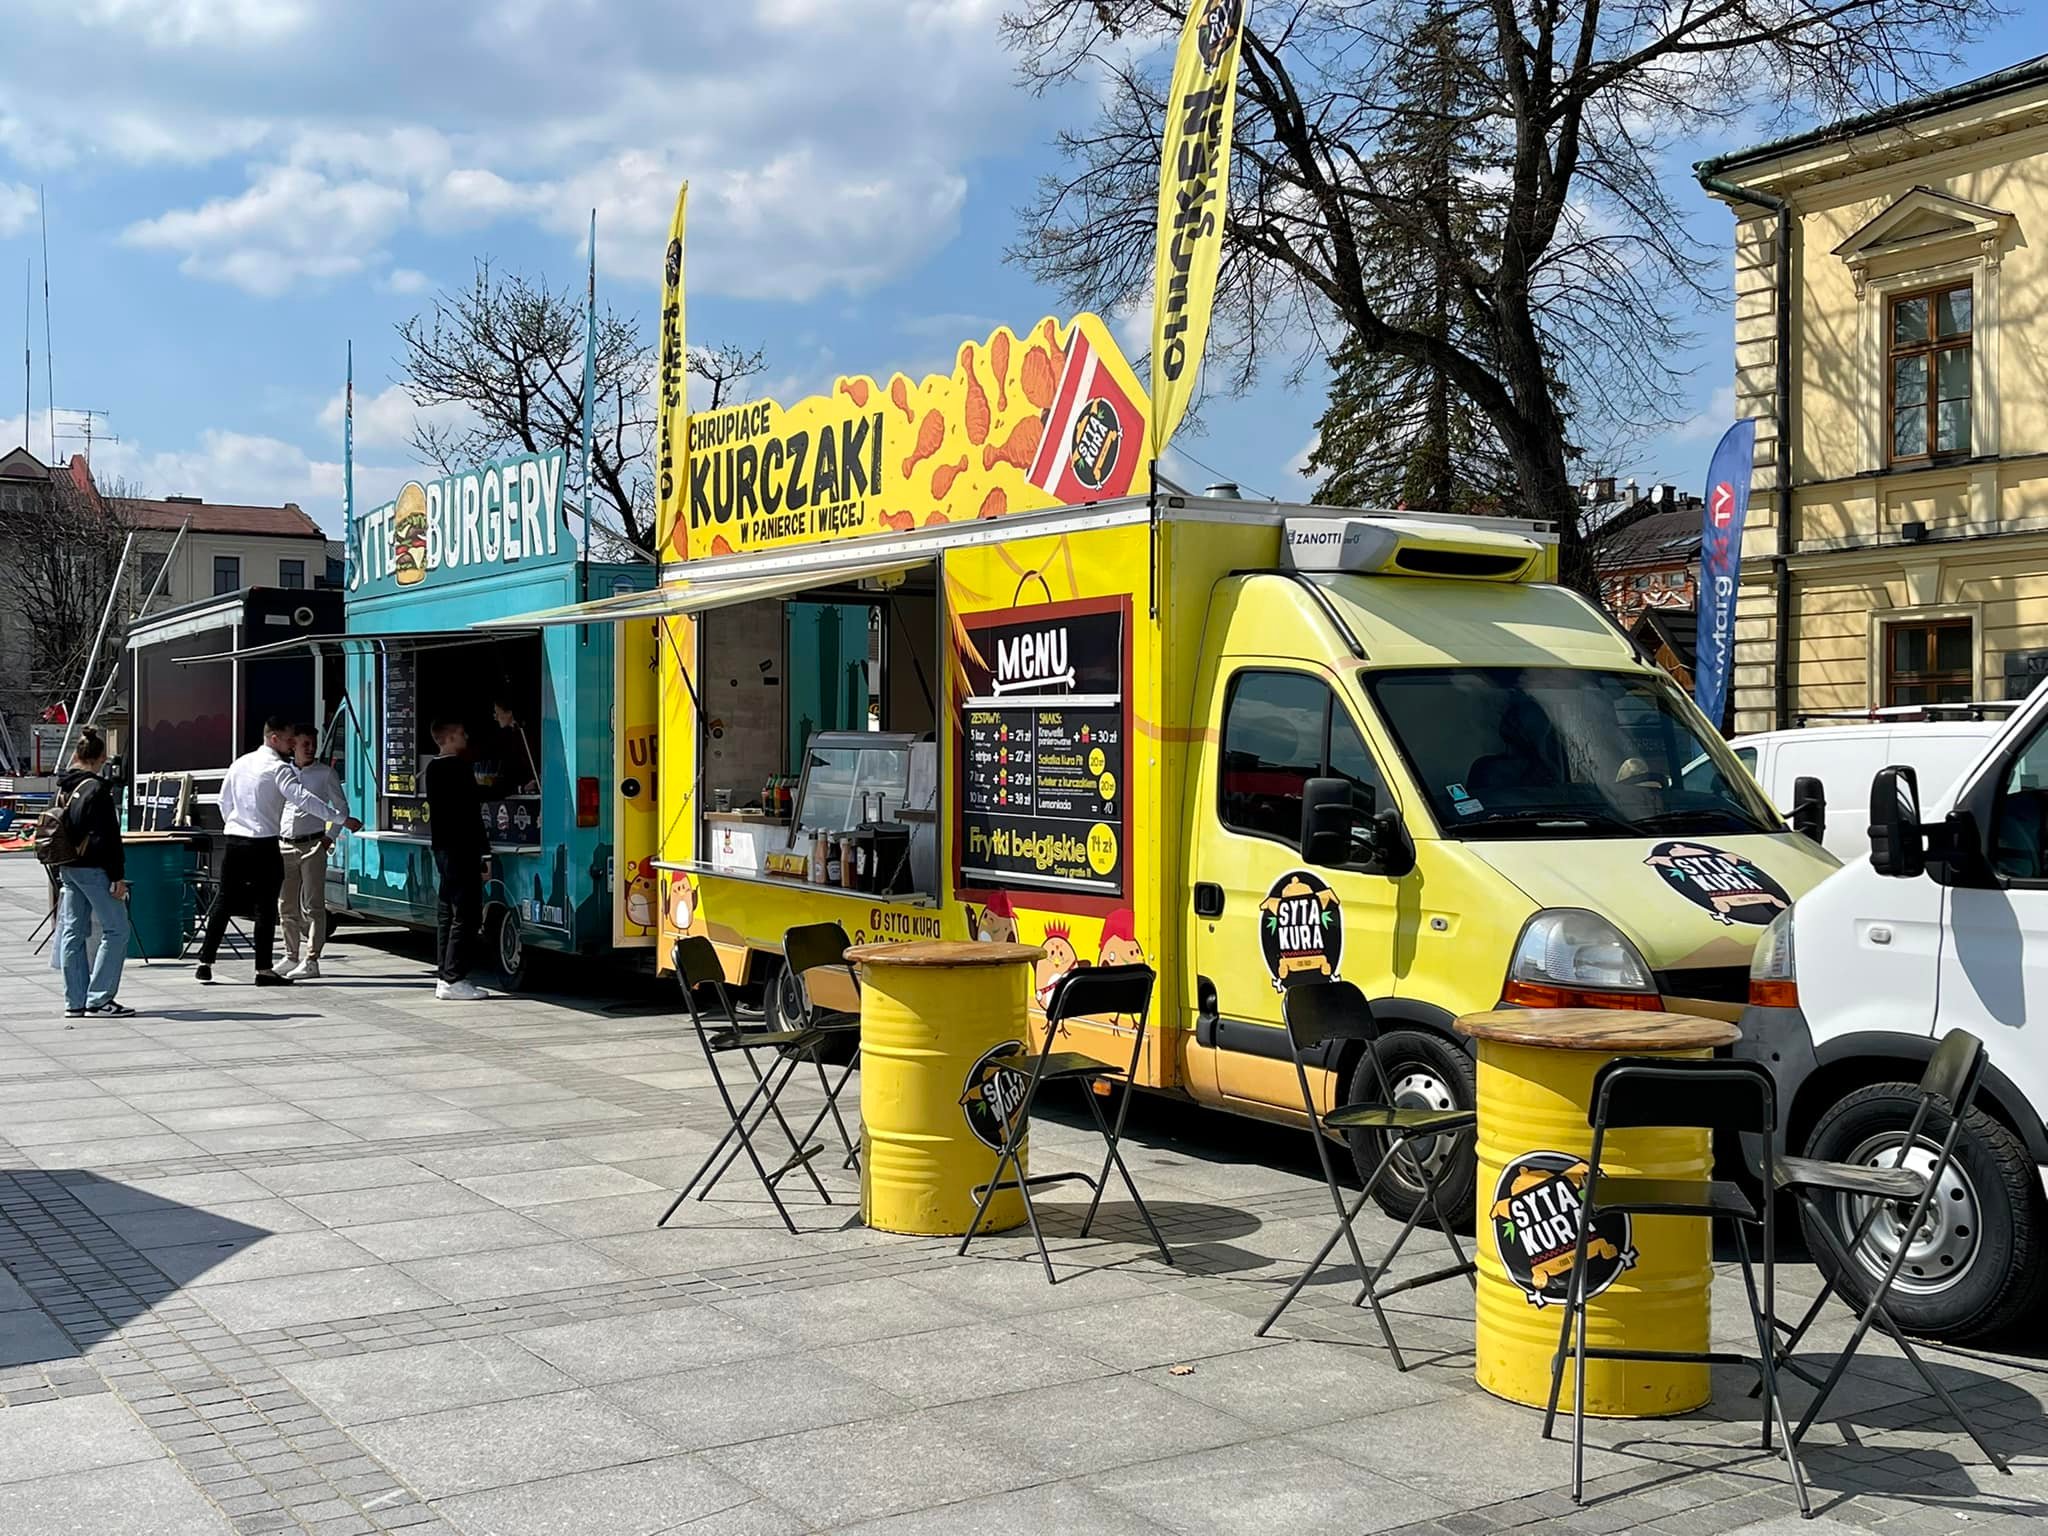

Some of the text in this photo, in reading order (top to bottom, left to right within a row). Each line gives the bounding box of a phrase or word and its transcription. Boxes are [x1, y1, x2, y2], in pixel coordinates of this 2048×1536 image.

[689, 402, 770, 452] CHRUPIĄCE
[1079, 416, 1100, 457] SYTA
[1084, 424, 1108, 467] KURA
[690, 412, 883, 529] KURCZAKI
[425, 455, 561, 570] BURGERY
[741, 501, 865, 544] W PANIERCE I WIĘCEJ
[1296, 533, 1341, 544] ZANOTTI
[1098, 731, 1108, 743] 30
[970, 826, 1086, 870] Frytki belgijskie
[1674, 856, 1740, 875] SYTA
[1690, 873, 1763, 892] KURA
[1279, 899, 1320, 926] SYTA
[1278, 925, 1324, 950] KURA
[983, 1071, 1022, 1103] STA
[1511, 1181, 1580, 1228] SYTA
